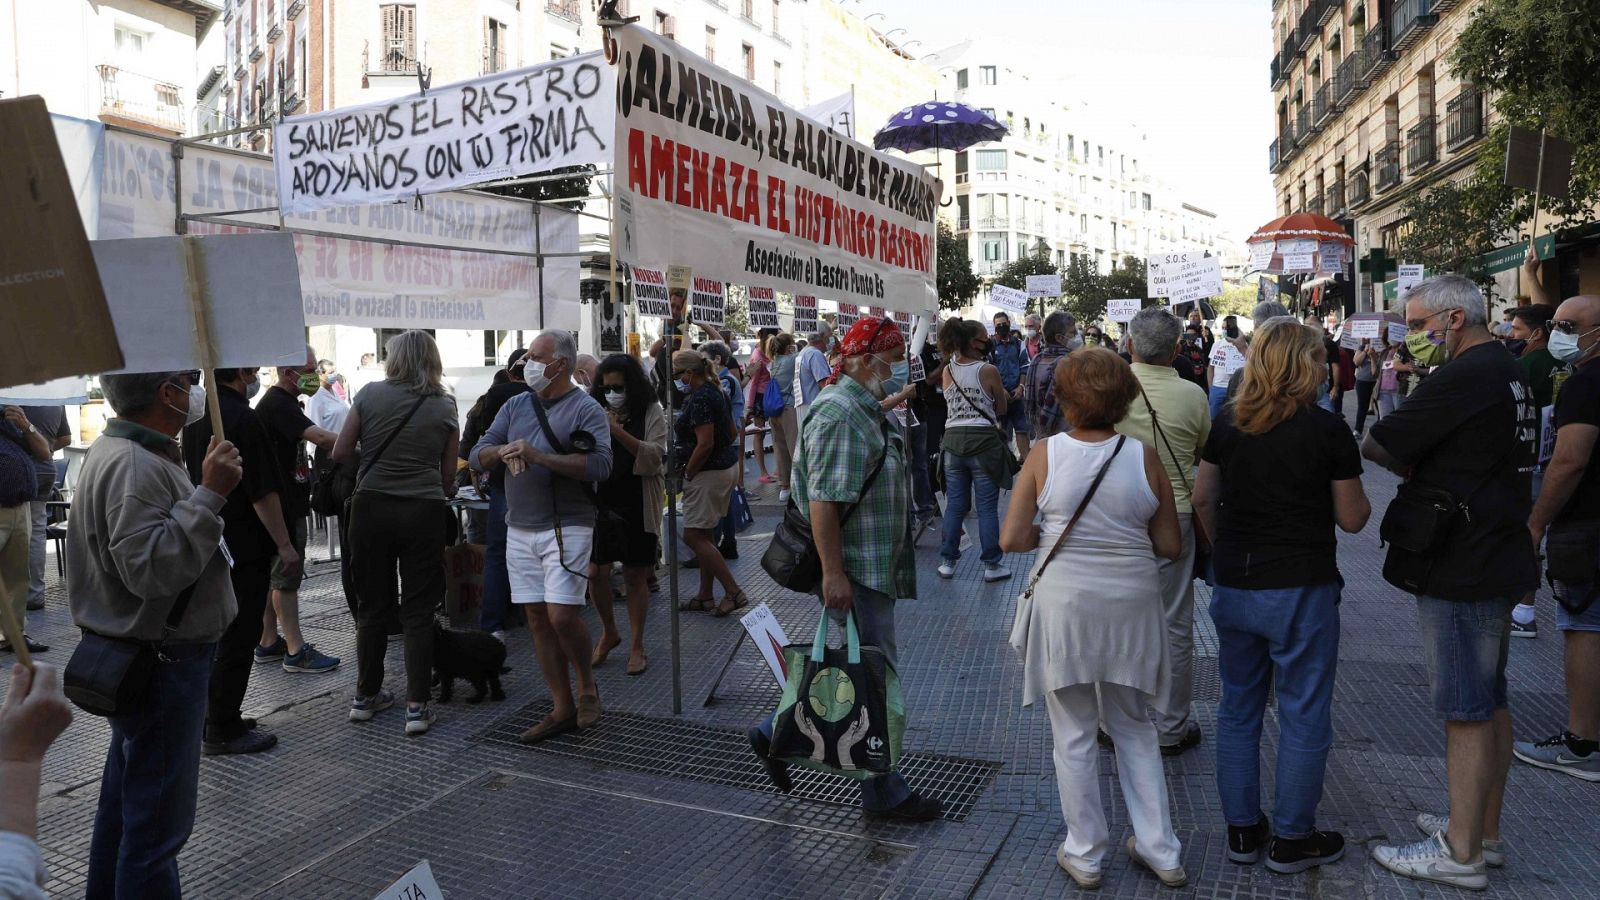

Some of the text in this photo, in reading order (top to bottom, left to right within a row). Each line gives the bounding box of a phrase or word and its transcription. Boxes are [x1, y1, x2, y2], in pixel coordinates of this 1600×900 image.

[289, 63, 601, 160] SALVEMOS EL RASTRO
[291, 105, 606, 200] APOYANOS CON TU FIRMA
[766, 104, 790, 165] EL
[868, 155, 890, 206] DE
[628, 127, 761, 227] AMENAZA
[767, 175, 791, 234] EL
[632, 266, 664, 286] NOVENO
[744, 239, 885, 299] Asociación el Rastro Punto Es
[634, 283, 669, 301] DOMINGO
[693, 276, 722, 295] NOVENO
[748, 285, 774, 300] NOVENO
[638, 300, 671, 317] EN LUCHA
[692, 292, 724, 309] DOMINGO
[748, 299, 777, 313] DOMINGO
[693, 307, 724, 323] EN LUCHA
[750, 313, 778, 327] EN LUCHA
[794, 307, 818, 320] DOMINGO
[1110, 307, 1138, 316] SORTEO
